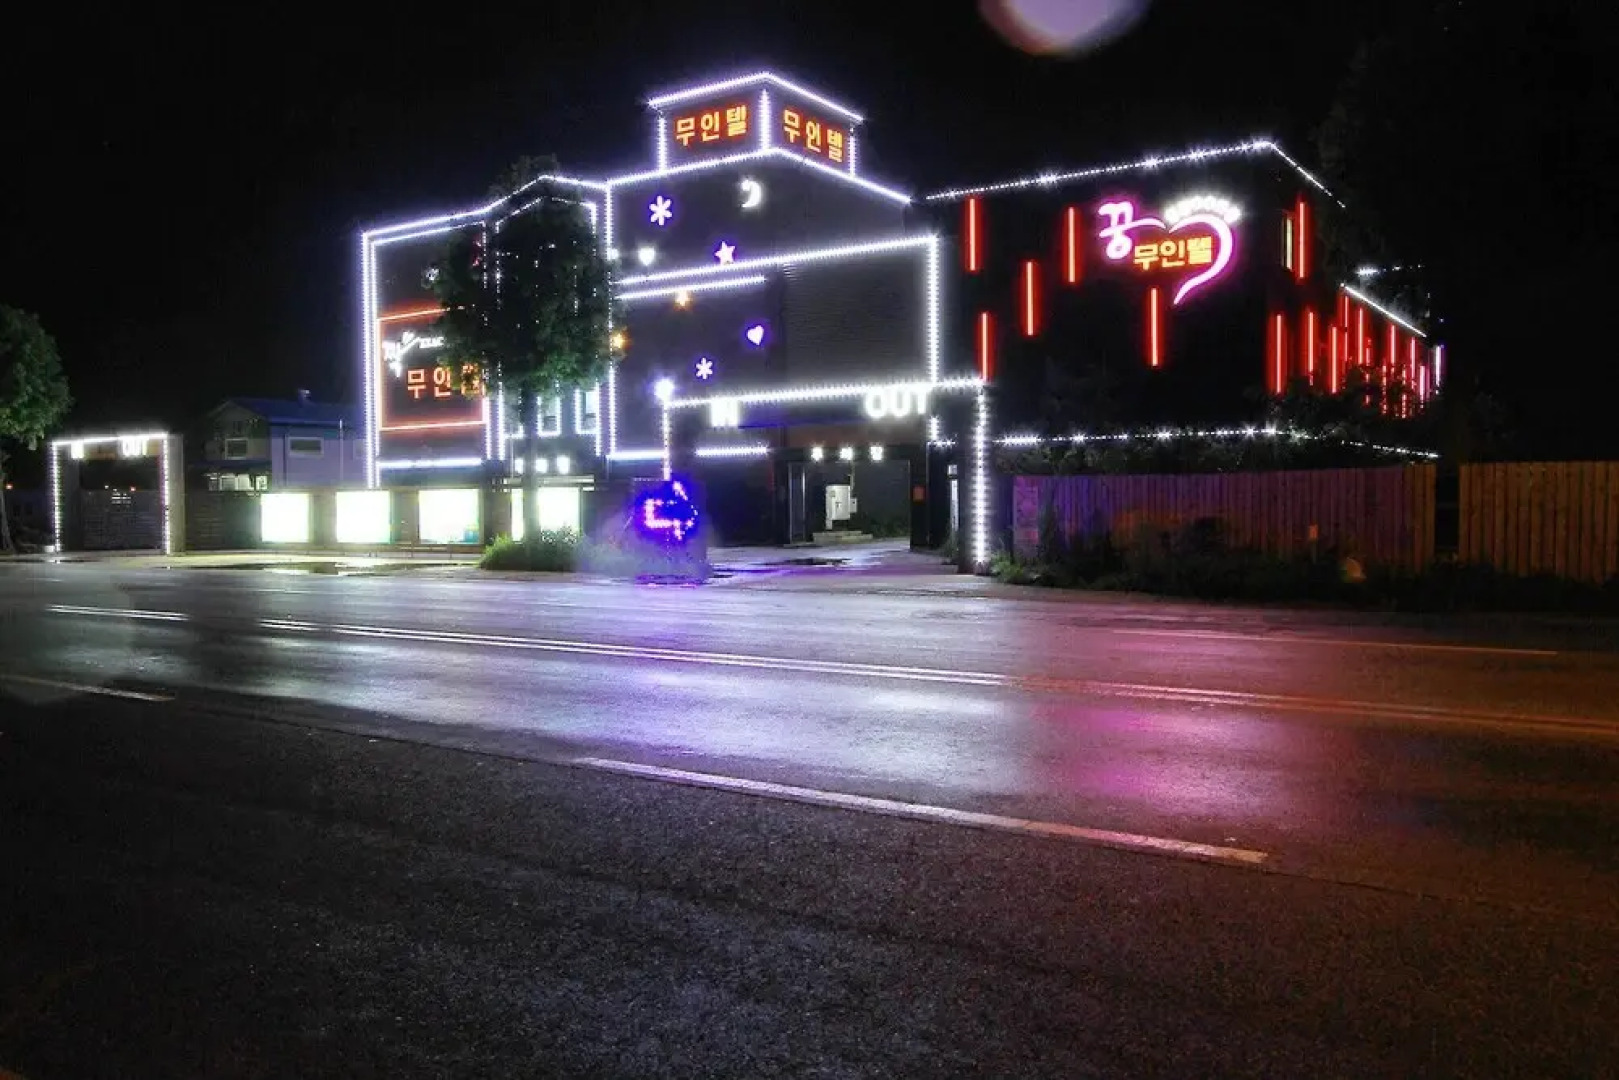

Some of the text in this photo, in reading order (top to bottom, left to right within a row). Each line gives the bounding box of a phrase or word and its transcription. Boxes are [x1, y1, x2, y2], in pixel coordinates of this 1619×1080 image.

[675, 105, 748, 146] 무인텔
[782, 109, 844, 162] 무인텔
[865, 387, 932, 419] OUT
